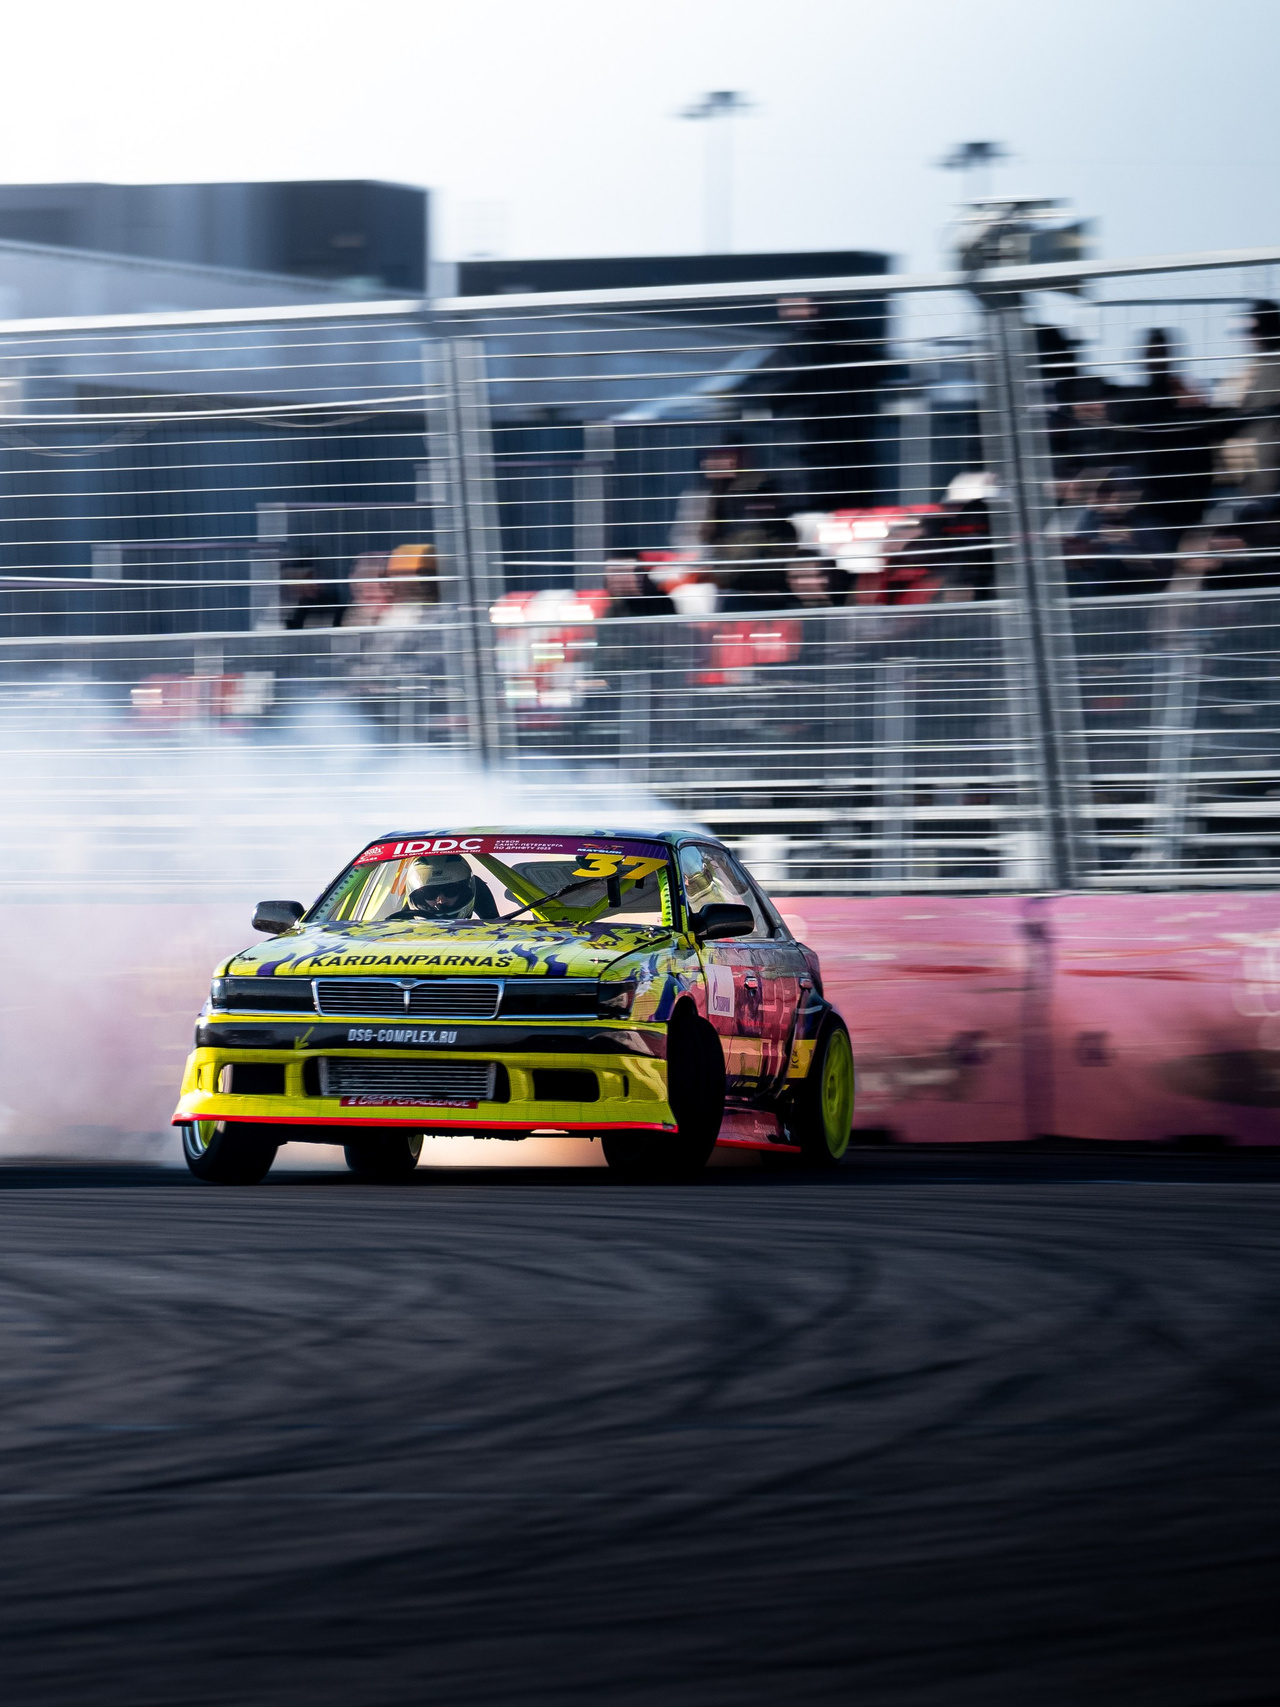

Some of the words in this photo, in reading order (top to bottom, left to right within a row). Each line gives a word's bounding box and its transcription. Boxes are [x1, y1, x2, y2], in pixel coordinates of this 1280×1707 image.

[393, 838, 484, 854] IDDC
[572, 853, 669, 880] 37
[347, 1029, 458, 1044] DSG-COMPLEX.RU
